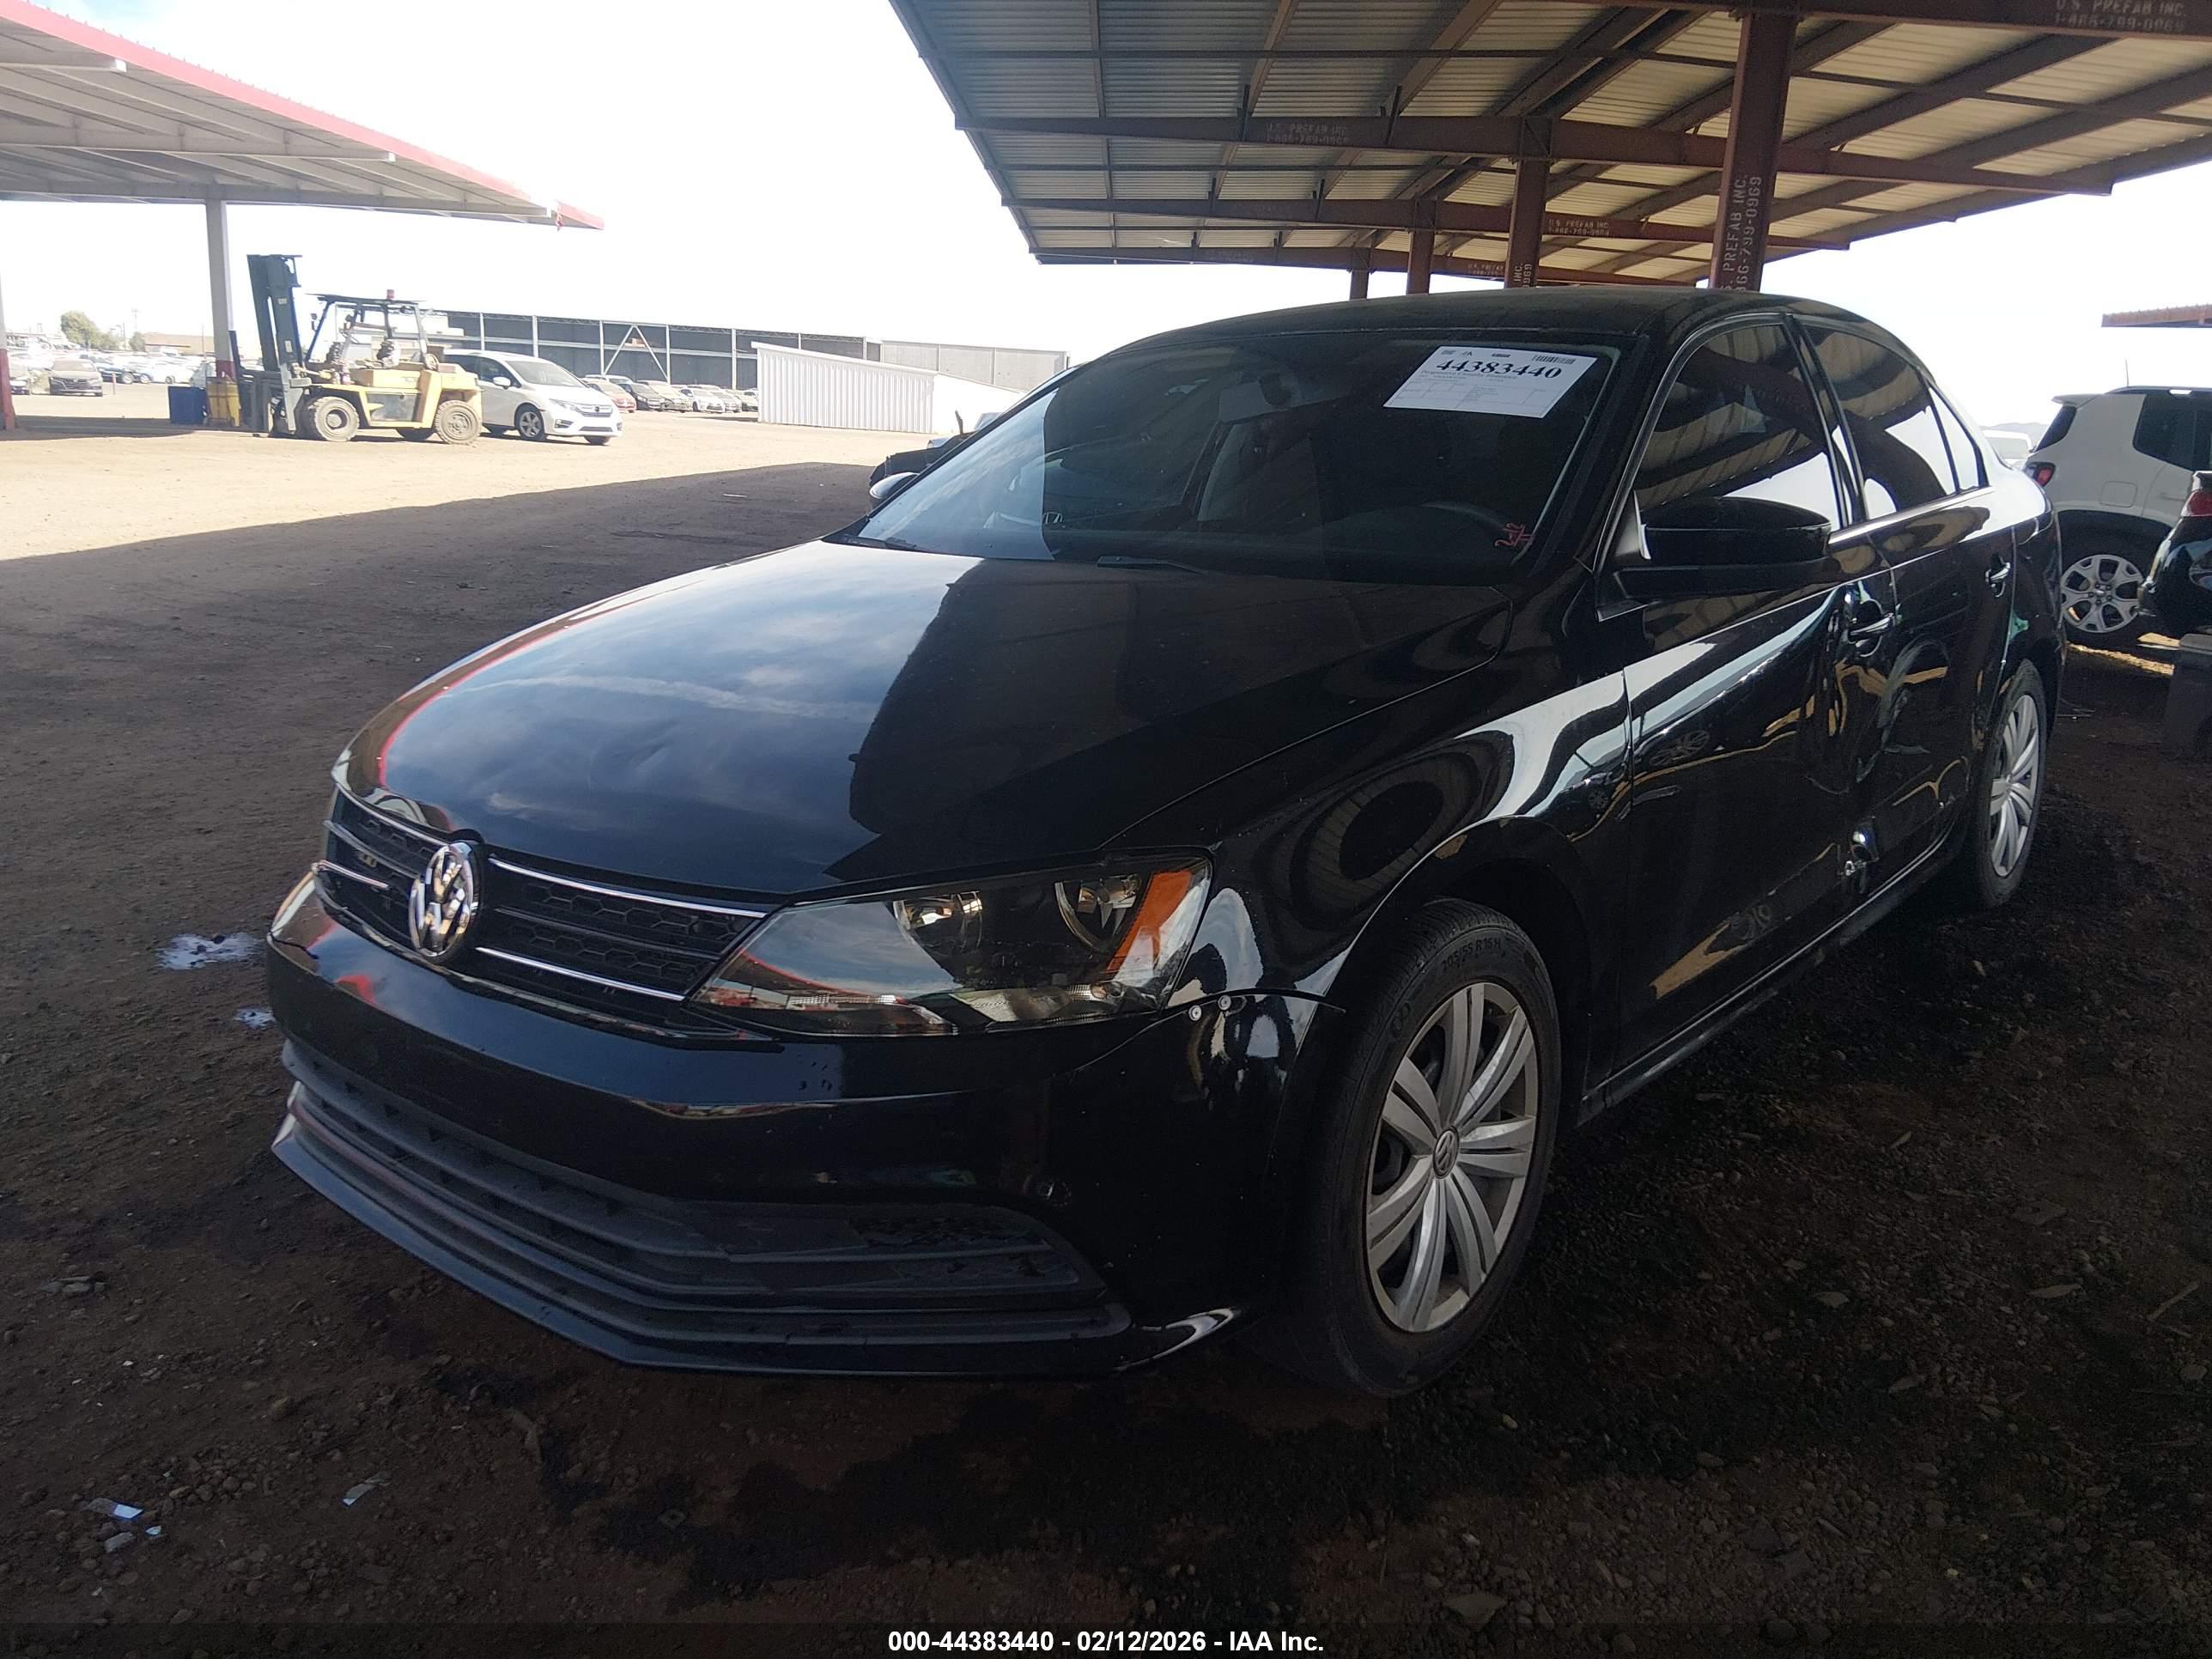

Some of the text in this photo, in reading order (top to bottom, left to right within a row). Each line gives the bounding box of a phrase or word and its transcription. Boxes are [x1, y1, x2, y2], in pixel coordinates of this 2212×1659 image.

[1722, 212, 1742, 271] PREFAB
[1733, 174, 1748, 204] INC.
[1437, 359, 1562, 379] 44383440
